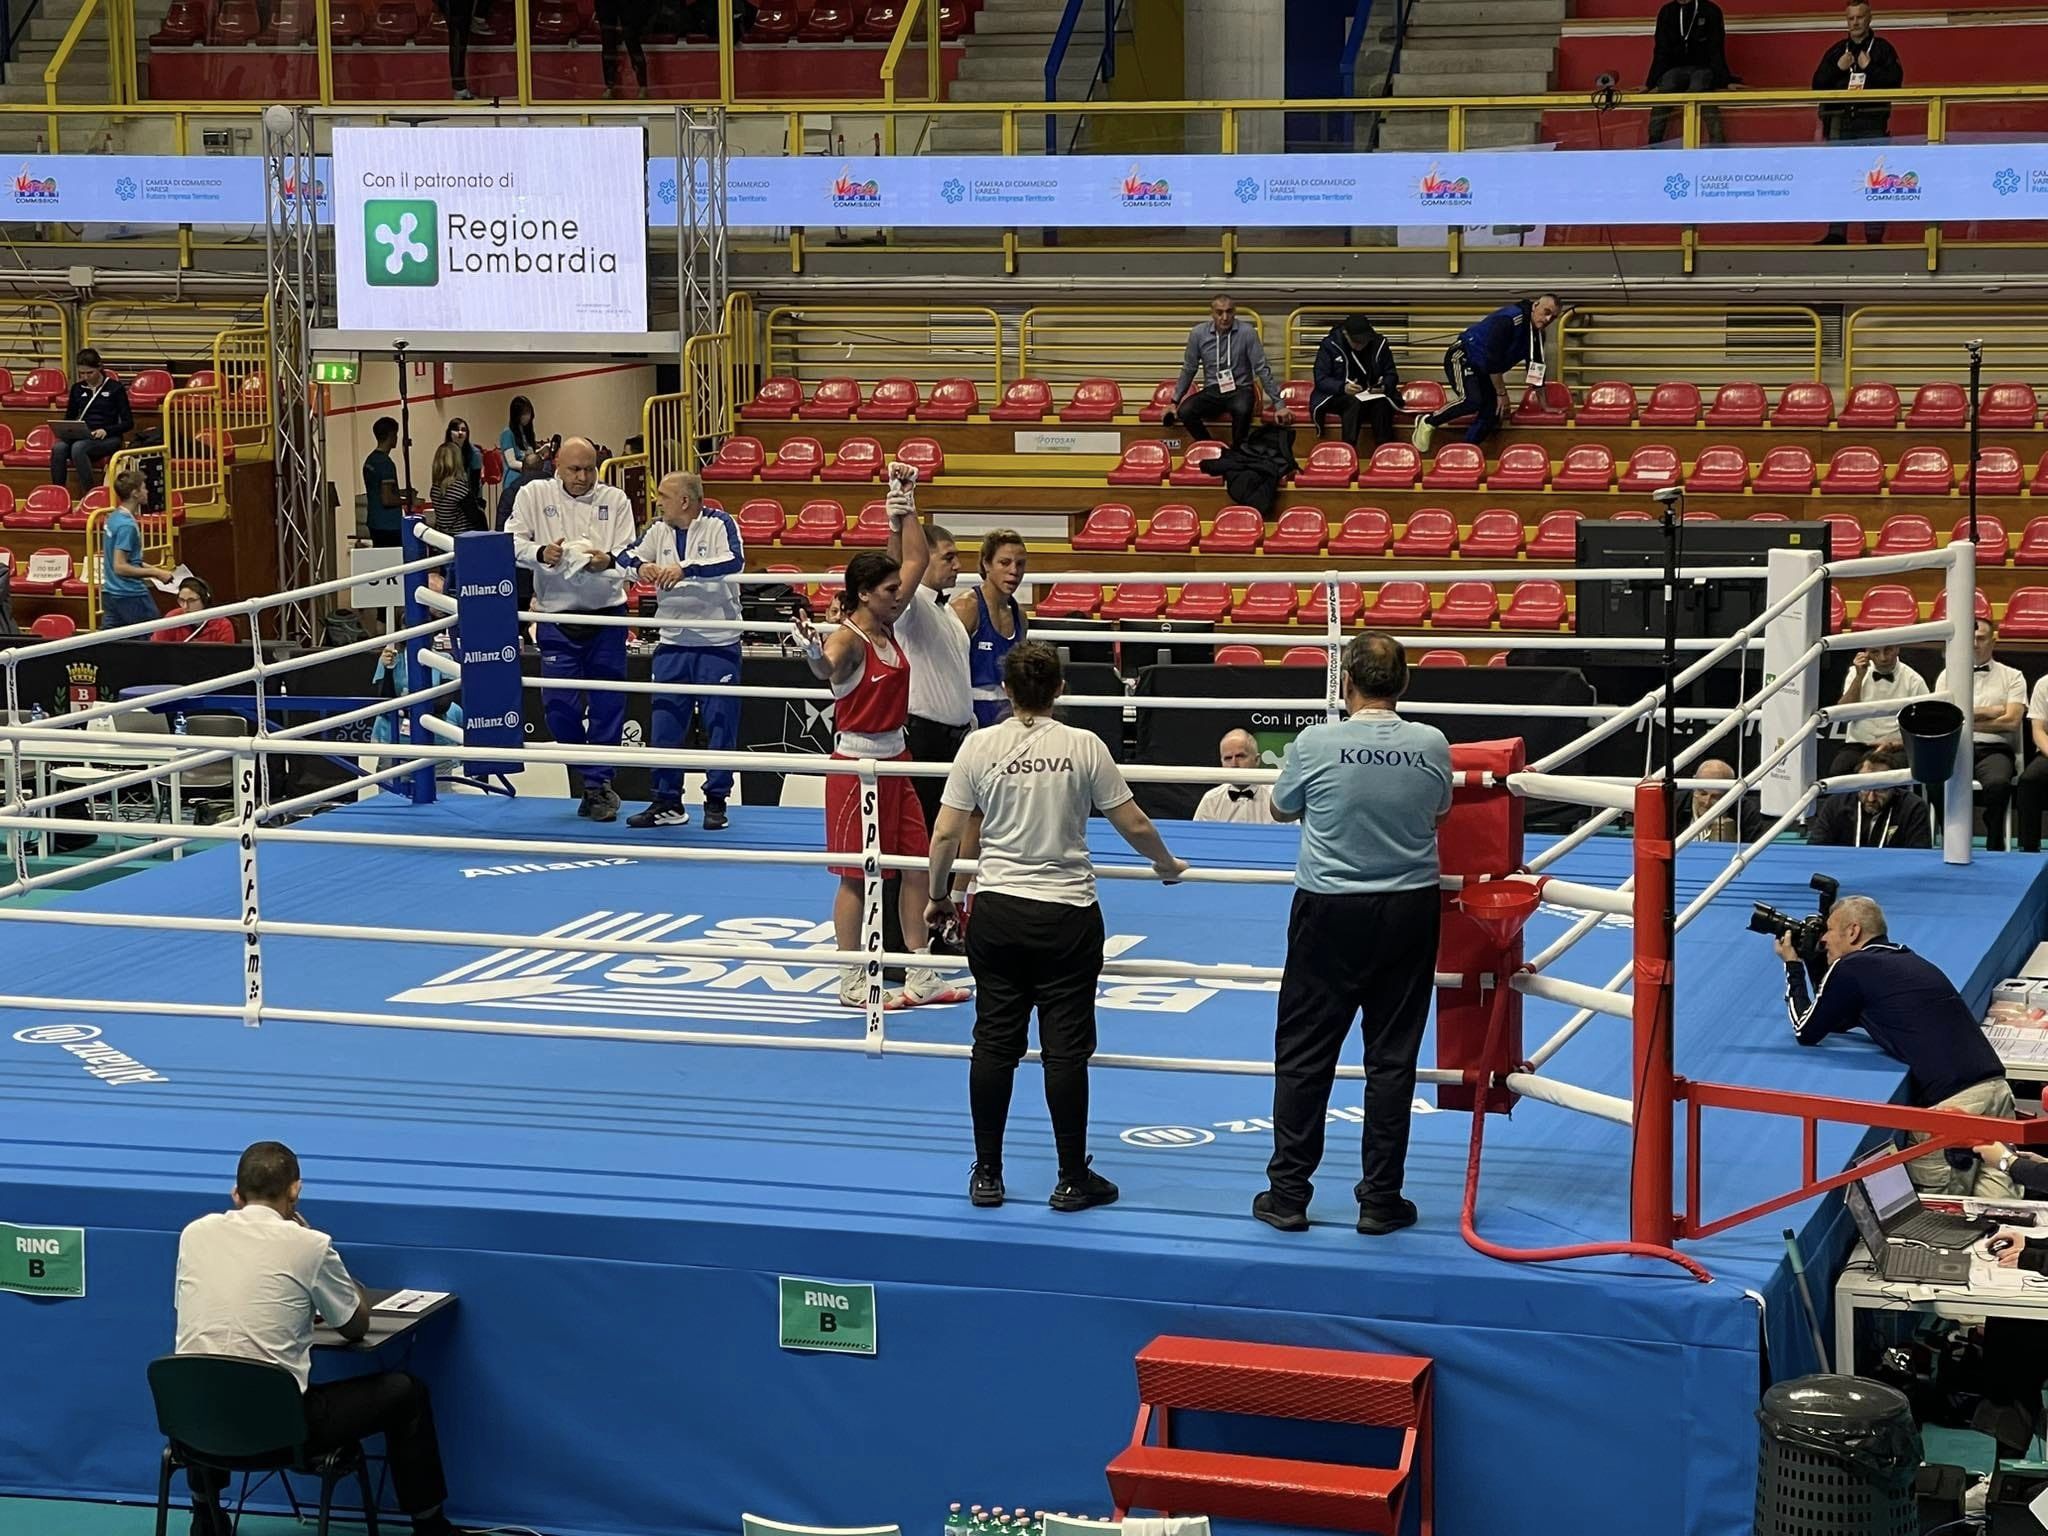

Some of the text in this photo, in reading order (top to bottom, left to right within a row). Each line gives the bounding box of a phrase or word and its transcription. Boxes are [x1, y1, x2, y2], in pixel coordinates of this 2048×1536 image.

[363, 172, 514, 190] Con il patronato di
[448, 214, 578, 246] Regione
[450, 246, 617, 273] Lombardia
[460, 584, 496, 597] Allianz
[464, 650, 500, 664] Allianz
[466, 717, 503, 730] Allianz
[1251, 713, 1279, 725] Con
[1284, 713, 1290, 725] il
[992, 758, 1074, 775] OSOVA
[1340, 748, 1426, 767] KOSOVA
[459, 858, 639, 878] Allianz
[62, 1041, 170, 1085] Allianz
[16, 1237, 59, 1254] RING
[29, 1259, 46, 1277] B
[804, 1291, 849, 1310] RING
[820, 1312, 837, 1332] B
